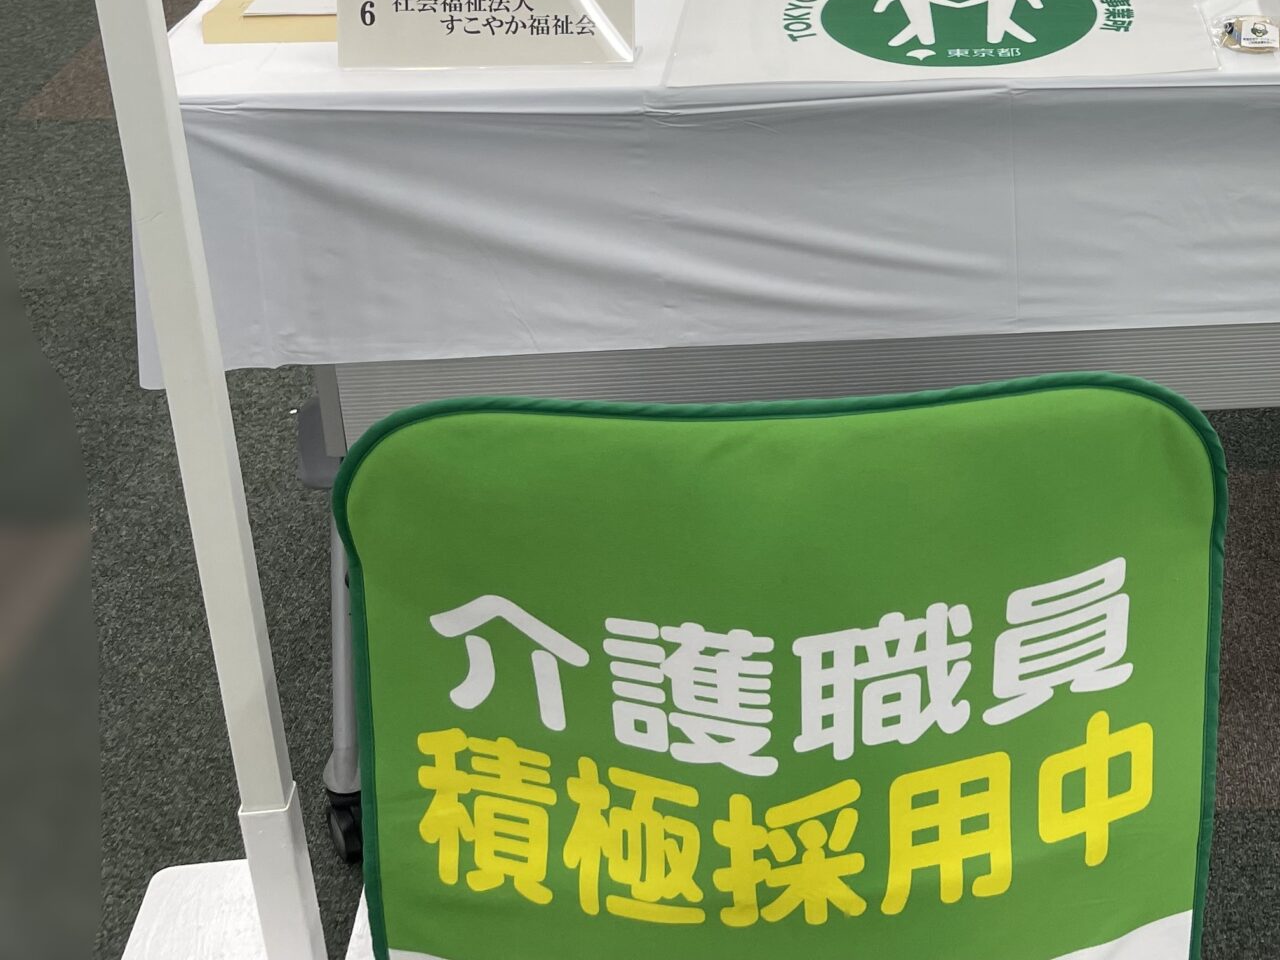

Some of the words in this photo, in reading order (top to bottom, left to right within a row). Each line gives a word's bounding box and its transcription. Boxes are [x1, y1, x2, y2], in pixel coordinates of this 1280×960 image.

[360, 0, 376, 26] 6
[440, 14, 596, 36] すこやか福祉会
[946, 47, 1022, 58] 東京都
[429, 556, 1134, 777] 介護職員
[416, 709, 1155, 928] 積極採用中
